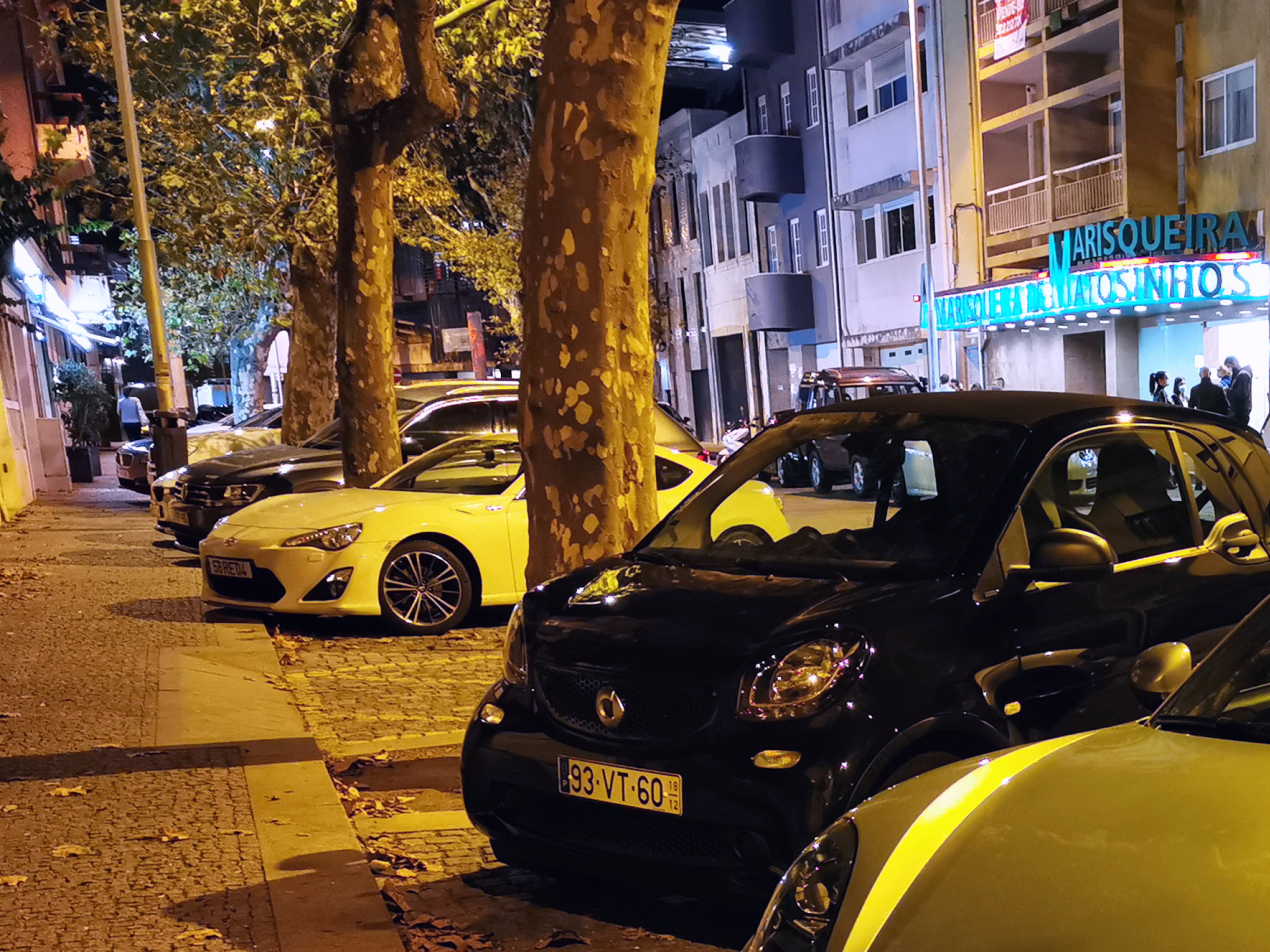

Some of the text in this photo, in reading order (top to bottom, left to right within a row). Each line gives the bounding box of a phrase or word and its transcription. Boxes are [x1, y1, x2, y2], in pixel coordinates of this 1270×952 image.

[1049, 211, 1249, 275] MARISQUEIRA
[669, 780, 679, 791] 18
[669, 799, 679, 810] 12
